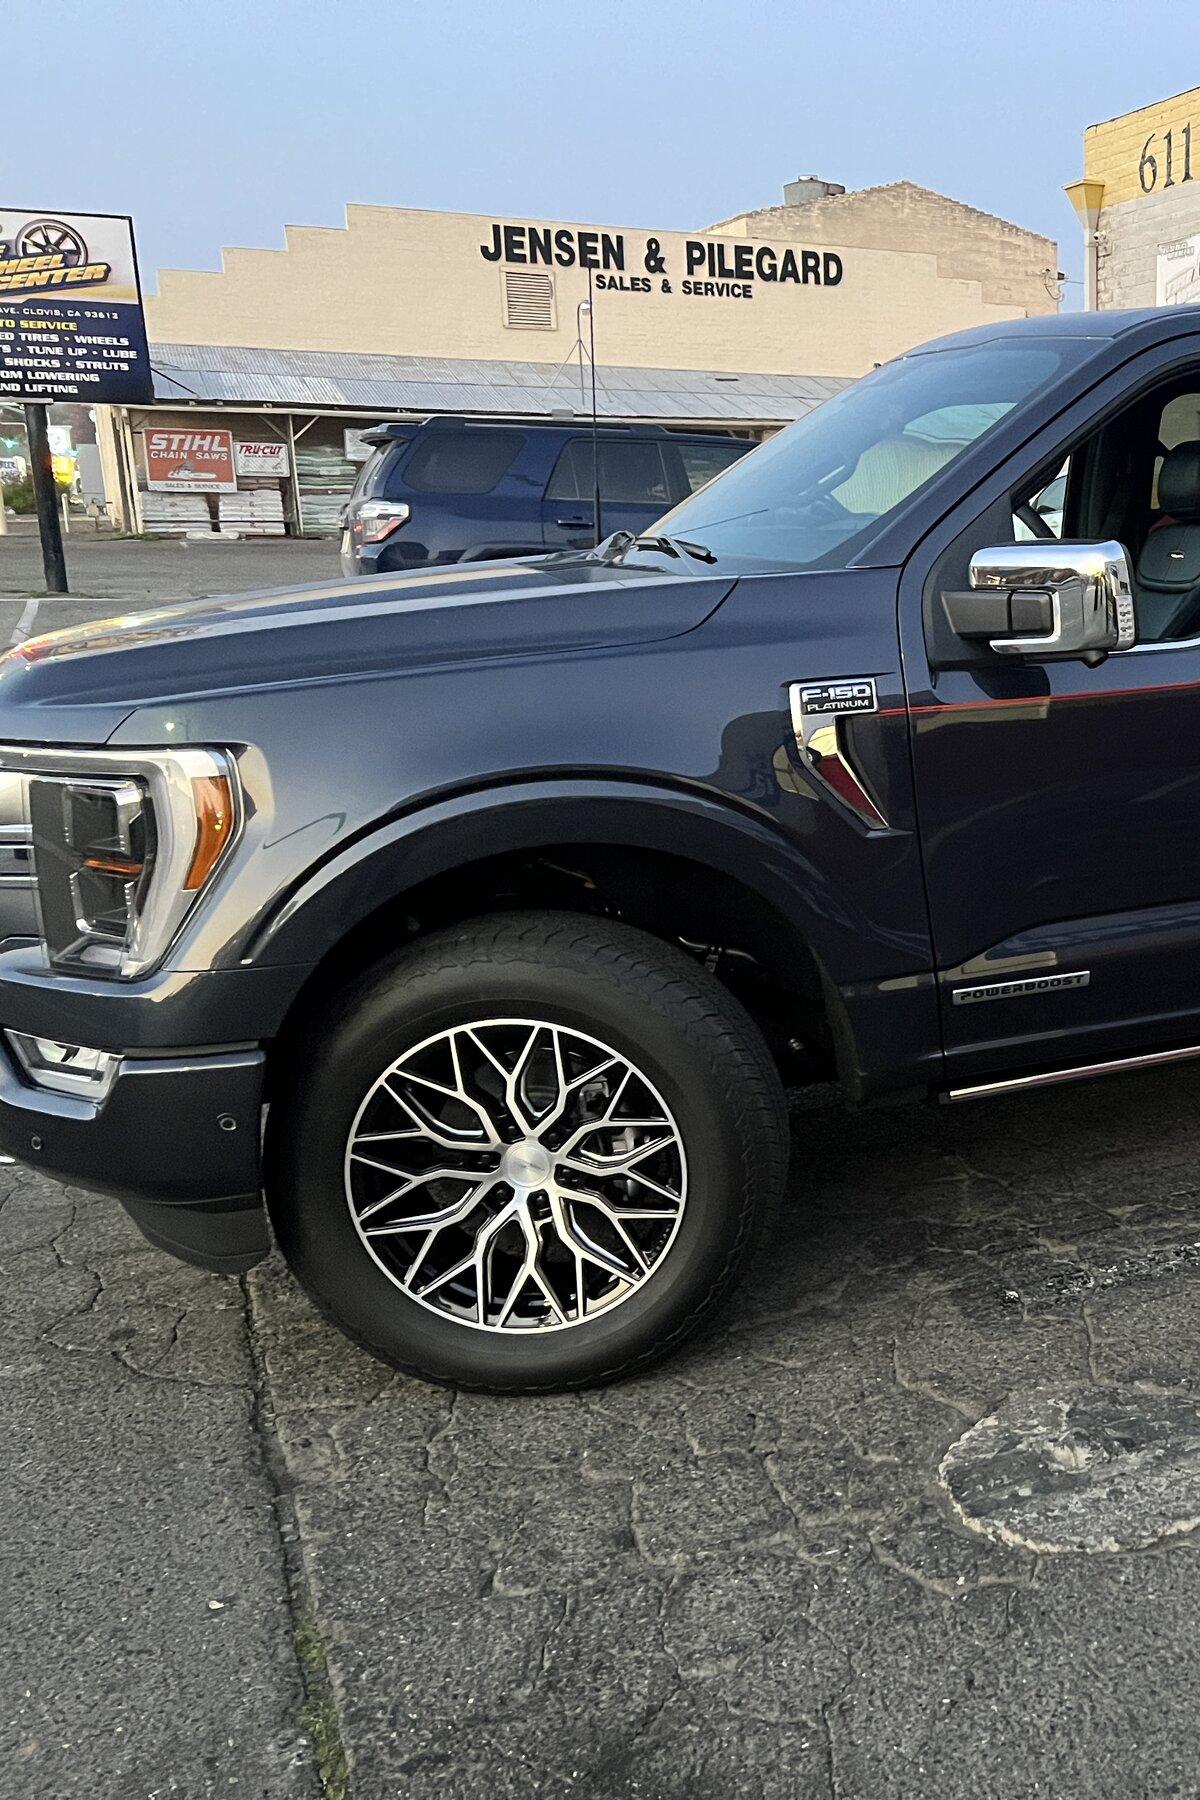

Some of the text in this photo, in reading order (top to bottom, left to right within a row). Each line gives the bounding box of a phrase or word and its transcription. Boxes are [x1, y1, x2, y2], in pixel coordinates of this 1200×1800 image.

[1138, 121, 1194, 193] 611
[480, 223, 844, 287] JENSEN & PILEGARD
[596, 274, 753, 299] SALES & SERVICE
[23, 307, 64, 317] CLOVIS,
[84, 311, 119, 320] 93612
[20, 320, 78, 331] SERVICE
[19, 332, 60, 342] TIRES
[74, 335, 129, 346] WHEELS
[27, 345, 63, 355] TUNE
[67, 347, 88, 356] UP
[102, 349, 138, 359] LUBE
[4, 357, 130, 371] SHOCKS STRUTS
[27, 371, 100, 382] LOWERING
[25, 383, 79, 394] LIFTING
[149, 433, 228, 452] STIHL
[150, 450, 228, 461] CHAIN SAWS
[239, 445, 283, 455] TRU-CUT
[801, 684, 872, 703] F-150
[807, 699, 869, 712] PLATINUM
[960, 975, 1085, 1001] POWERBOOST
